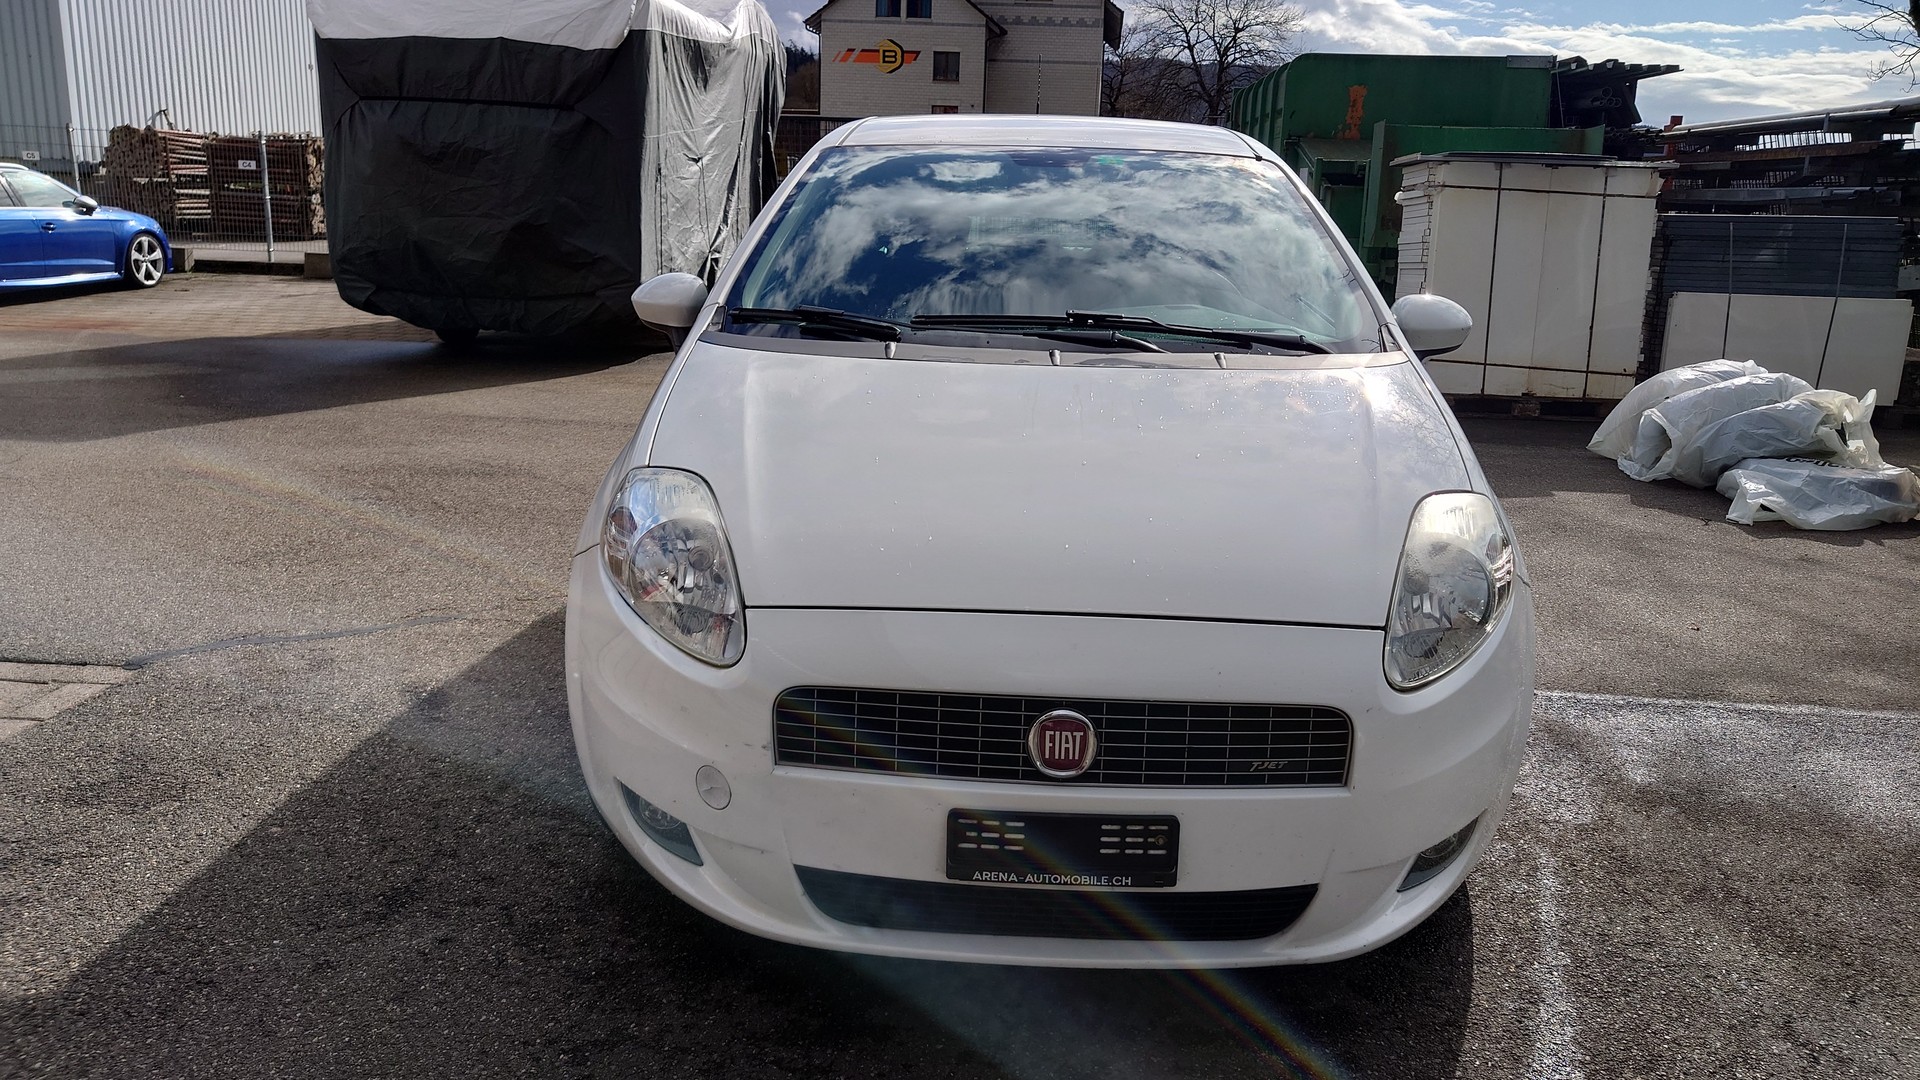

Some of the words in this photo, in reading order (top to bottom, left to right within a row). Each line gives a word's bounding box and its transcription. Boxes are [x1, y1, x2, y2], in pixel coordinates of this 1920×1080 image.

[882, 49, 898, 64] B
[1044, 730, 1084, 760] FIAT
[972, 870, 1132, 886] ARENA-AUTOMOBILE.CH
